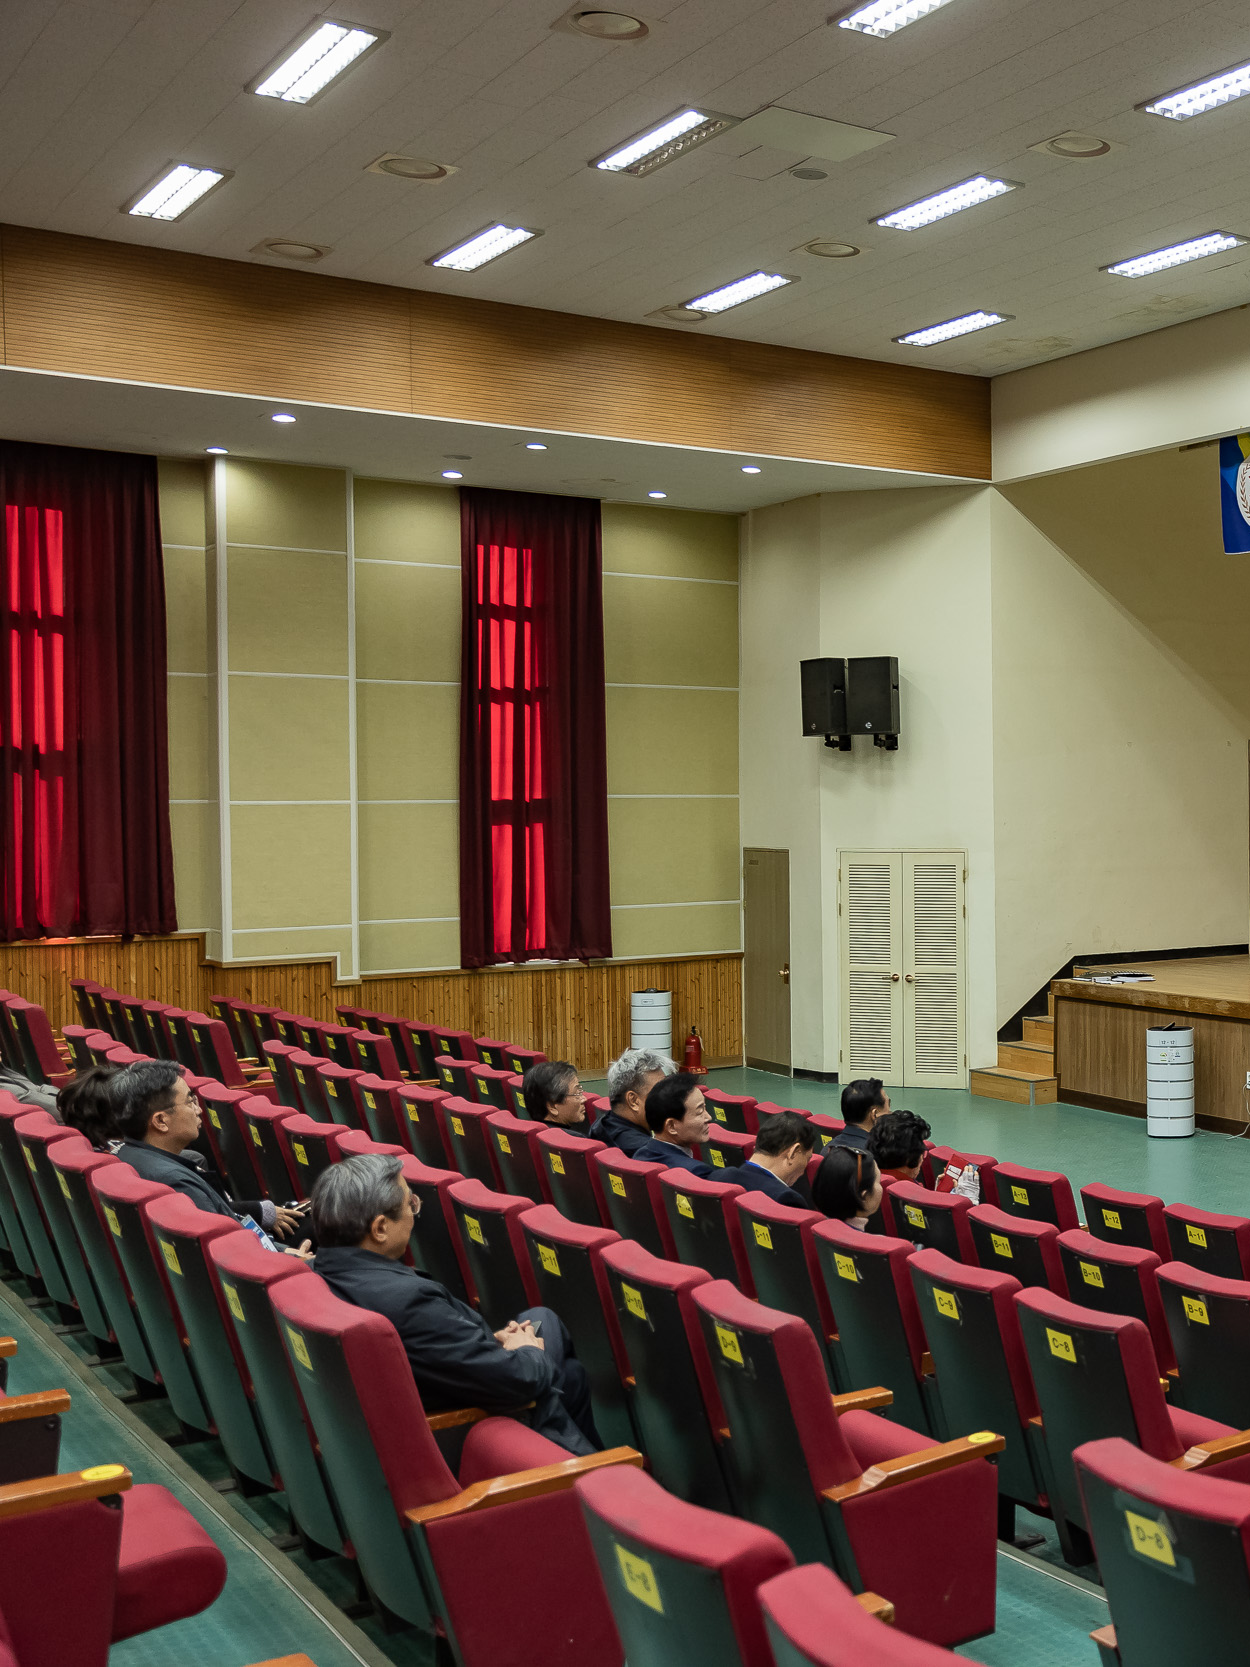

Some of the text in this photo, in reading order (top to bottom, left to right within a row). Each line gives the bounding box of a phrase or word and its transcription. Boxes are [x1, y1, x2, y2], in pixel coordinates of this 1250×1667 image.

[610, 1179, 624, 1191] C-13
[1013, 1190, 1028, 1201] A-13
[1104, 1214, 1120, 1225] A-12
[466, 1221, 482, 1237] D-12
[755, 1228, 770, 1242] C-11
[1188, 1230, 1205, 1242] A-11
[993, 1239, 1010, 1252] B-11
[540, 1251, 558, 1268] D-11
[836, 1260, 855, 1275] C-10
[1082, 1267, 1101, 1282] B-10
[624, 1291, 644, 1311] D-10
[938, 1296, 954, 1311] C-9
[1187, 1303, 1204, 1317] B-9
[720, 1335, 737, 1353] D-9
[1051, 1337, 1071, 1353] C-8
[1135, 1524, 1165, 1550] D-8
